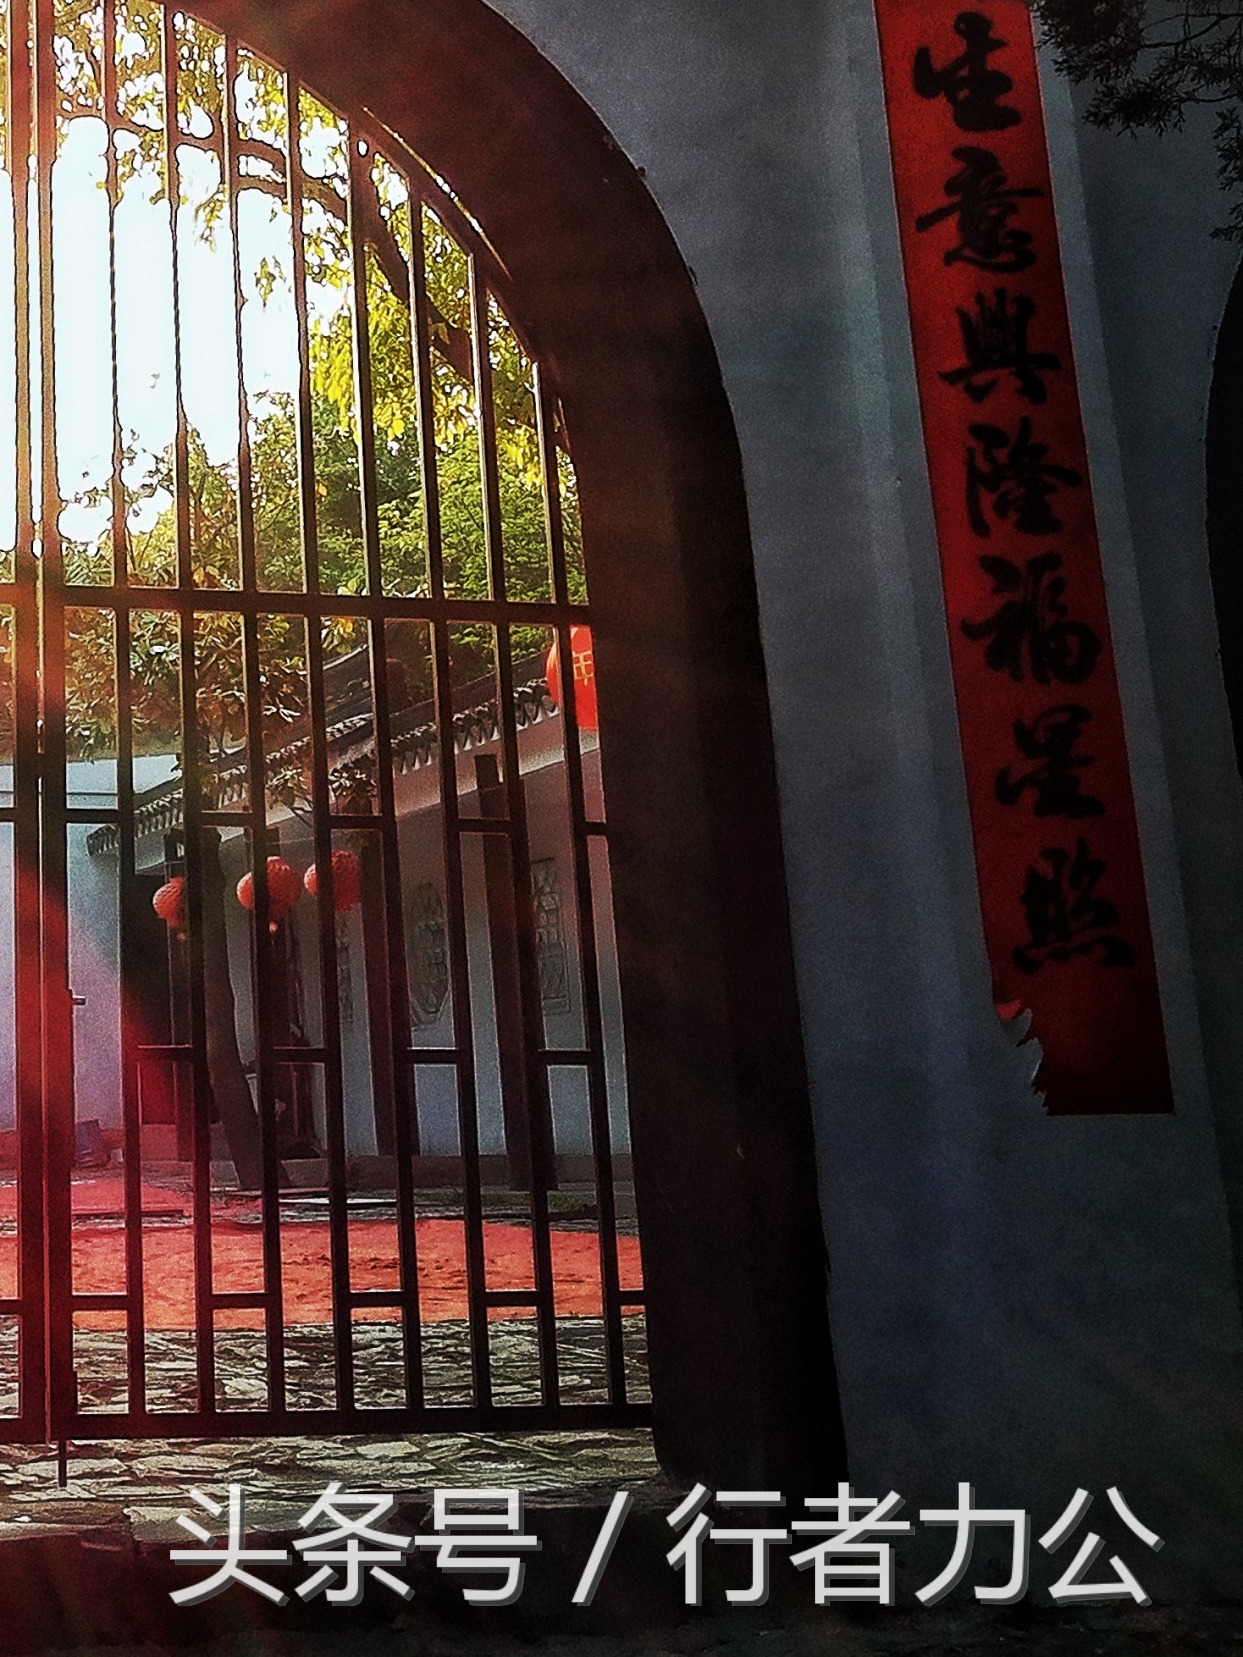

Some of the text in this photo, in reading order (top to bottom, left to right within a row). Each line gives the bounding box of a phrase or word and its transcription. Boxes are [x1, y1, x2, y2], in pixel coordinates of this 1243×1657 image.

[911, 10, 1135, 974] 生意興隆福星照
